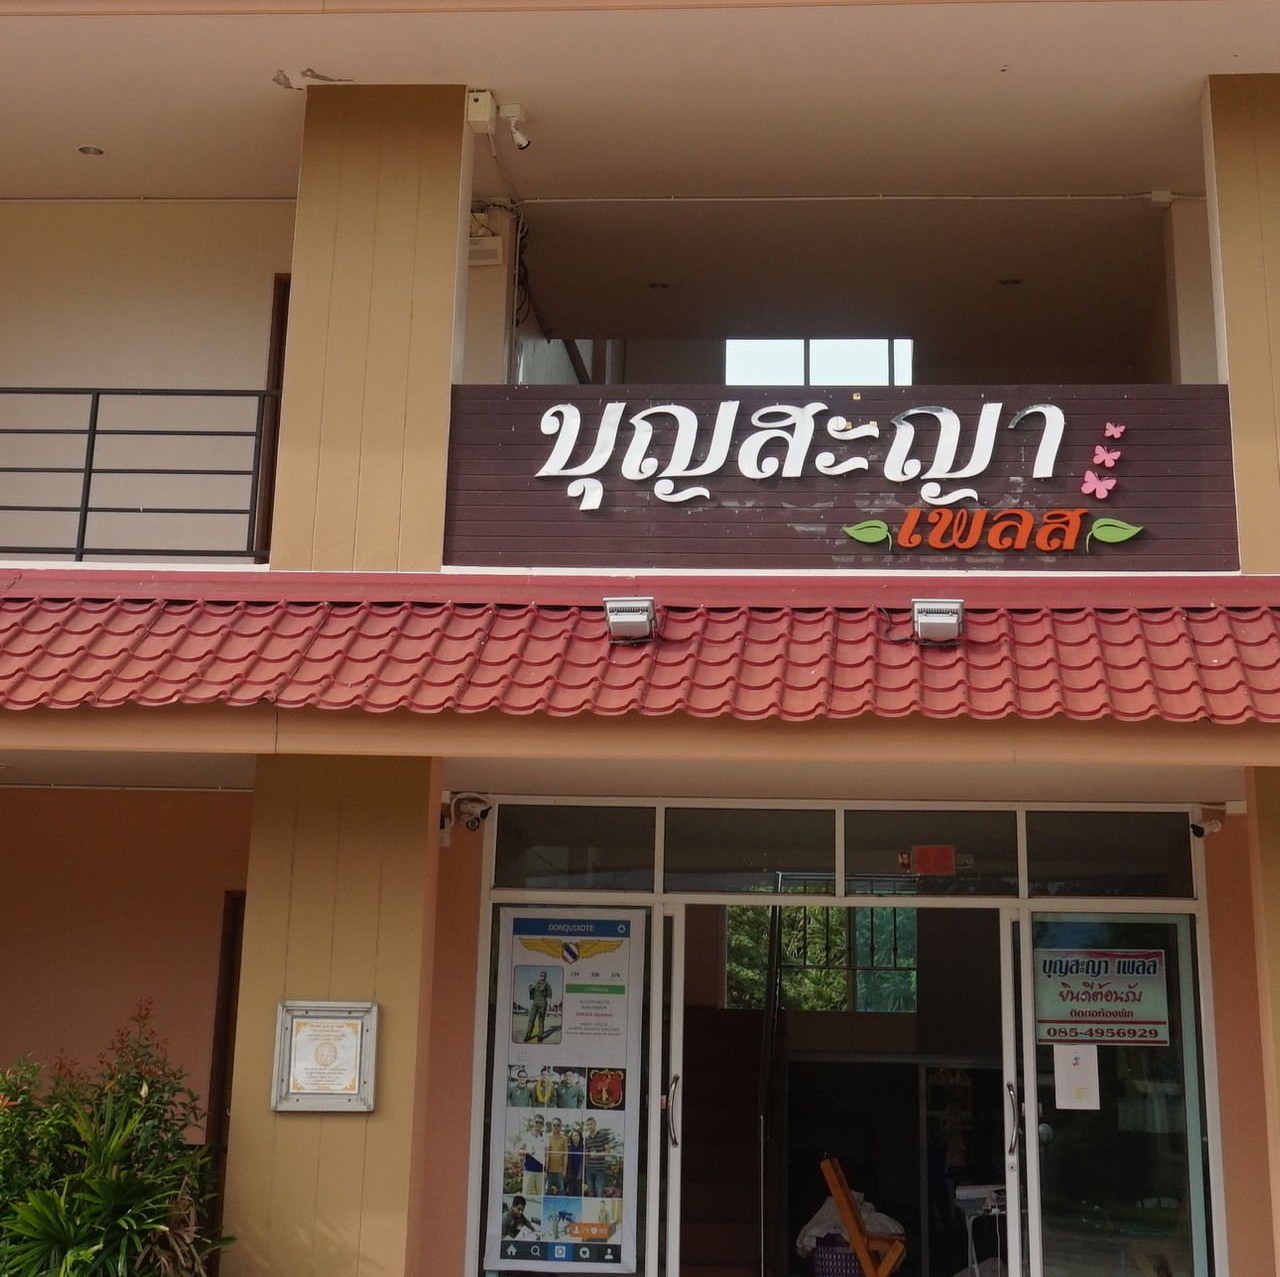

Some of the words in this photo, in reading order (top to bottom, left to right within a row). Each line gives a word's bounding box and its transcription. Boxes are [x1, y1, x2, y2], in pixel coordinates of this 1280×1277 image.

[534, 399, 1066, 511] บุญสะญา
[896, 506, 1088, 552] เพลส
[1042, 958, 1110, 979] บุญสะญา
[1116, 958, 1158, 976] เพลส
[1058, 981, 1143, 1003] ยินดีต้อนรับ
[1046, 1027, 1160, 1039] 085-4956929
